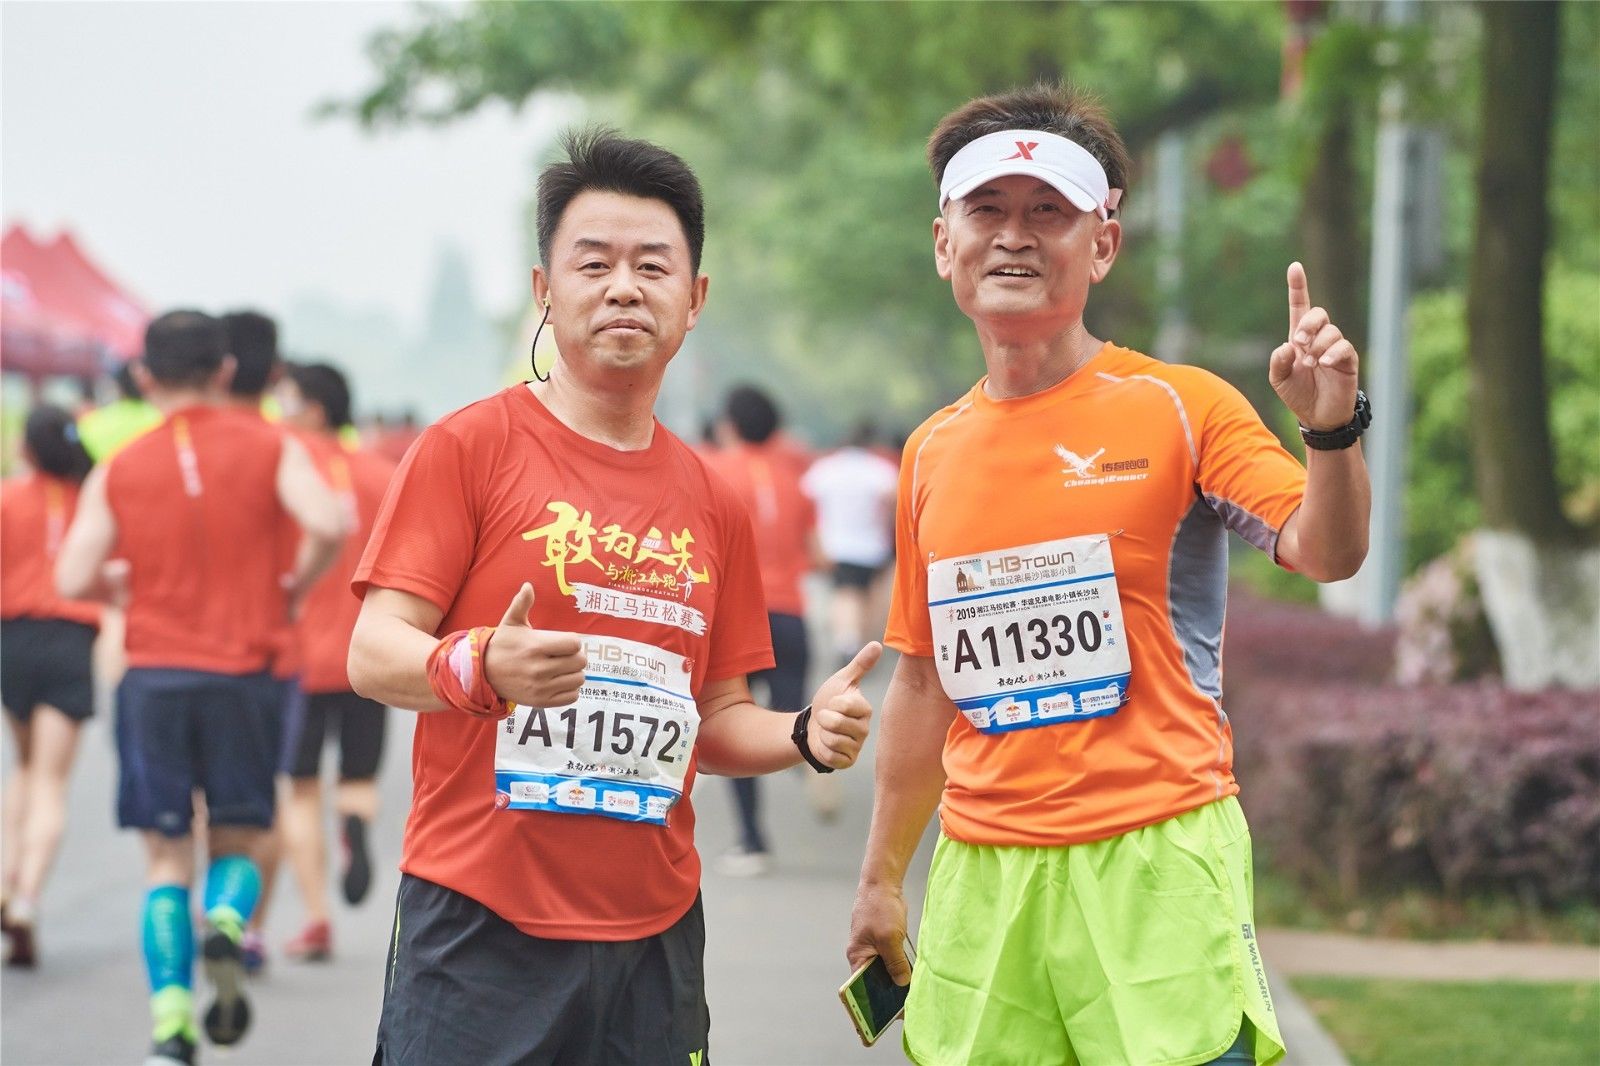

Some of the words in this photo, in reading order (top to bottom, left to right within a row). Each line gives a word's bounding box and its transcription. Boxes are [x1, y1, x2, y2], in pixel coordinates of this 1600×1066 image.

[584, 590, 694, 629] 湘江马拉松赛
[956, 607, 976, 620] 2019
[954, 610, 1102, 674] A11330
[518, 706, 682, 764] A11572
